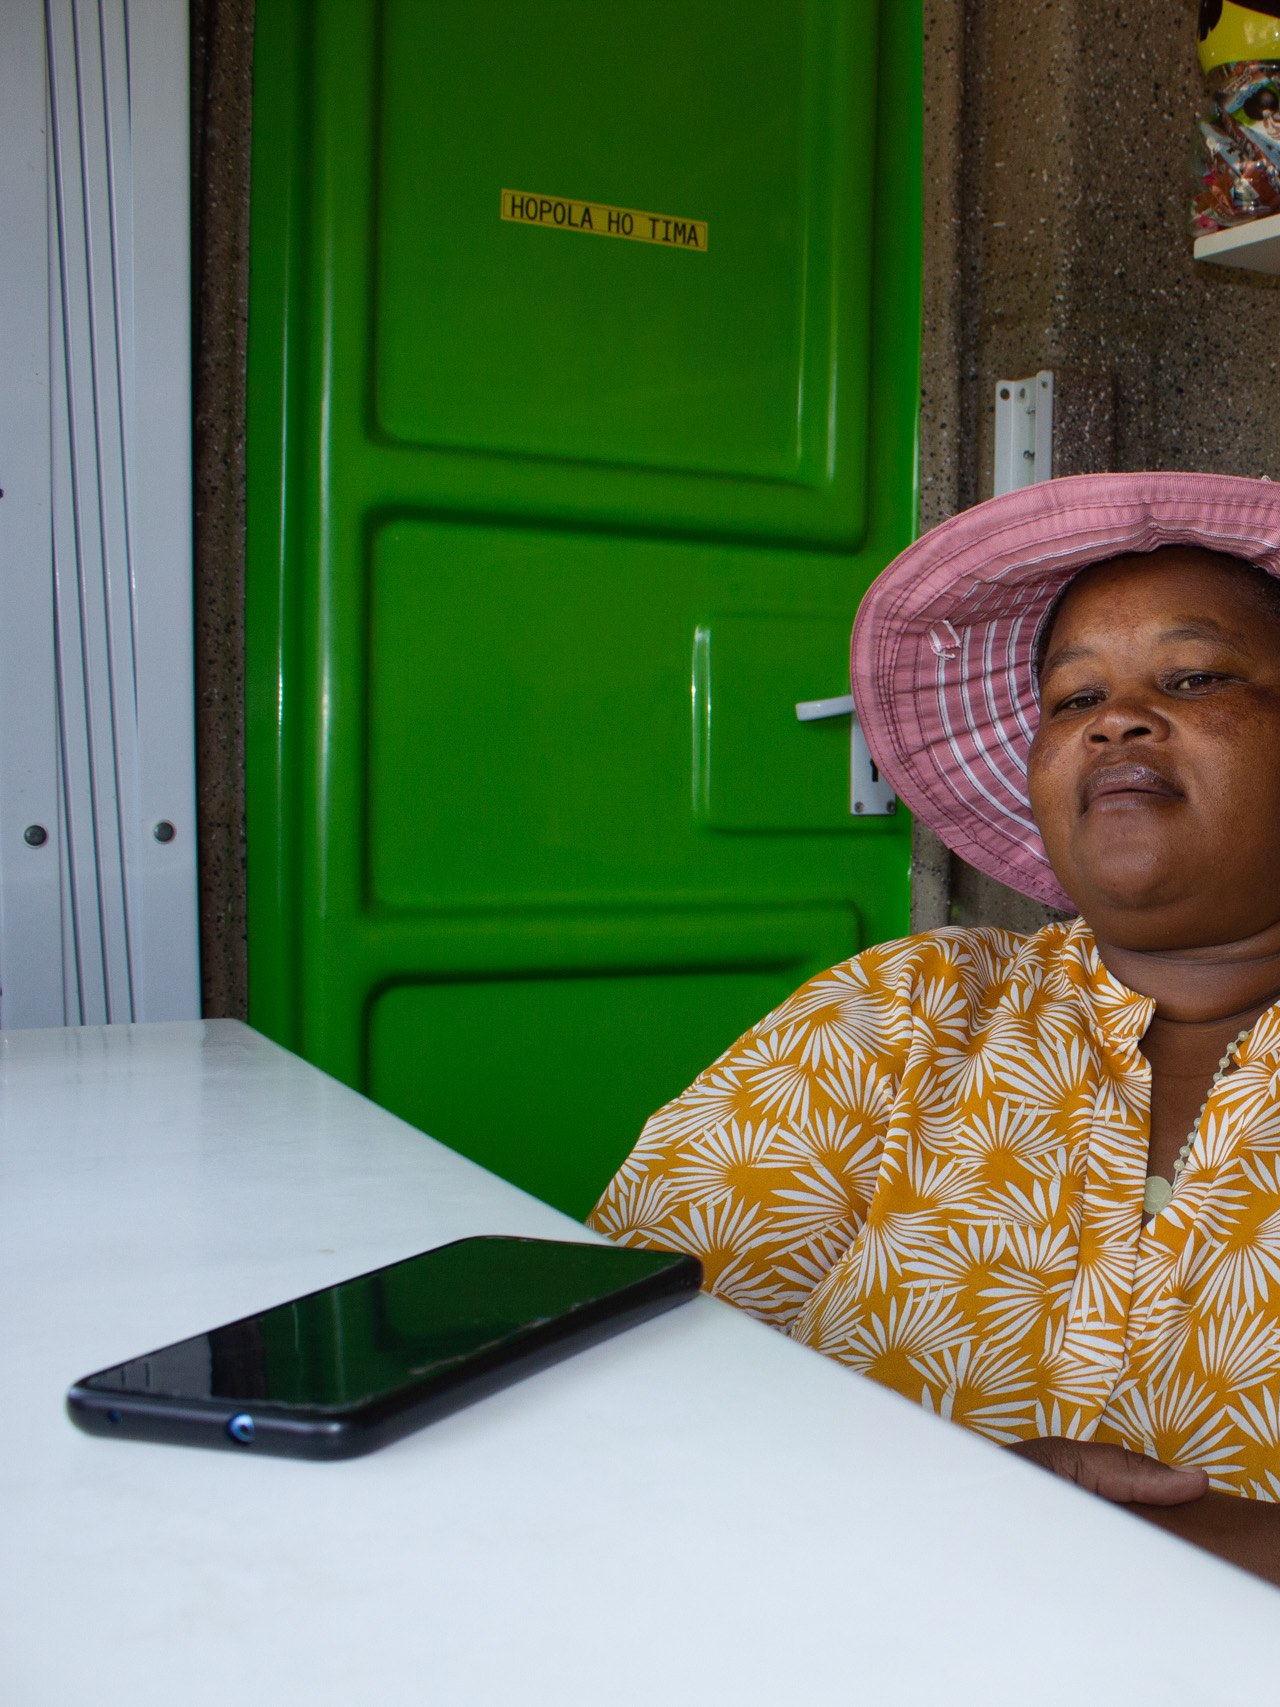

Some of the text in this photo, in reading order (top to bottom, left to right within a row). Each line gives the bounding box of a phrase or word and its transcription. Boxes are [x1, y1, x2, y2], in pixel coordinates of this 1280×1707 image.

[511, 195, 699, 246] HOPOLA HO TIMA
